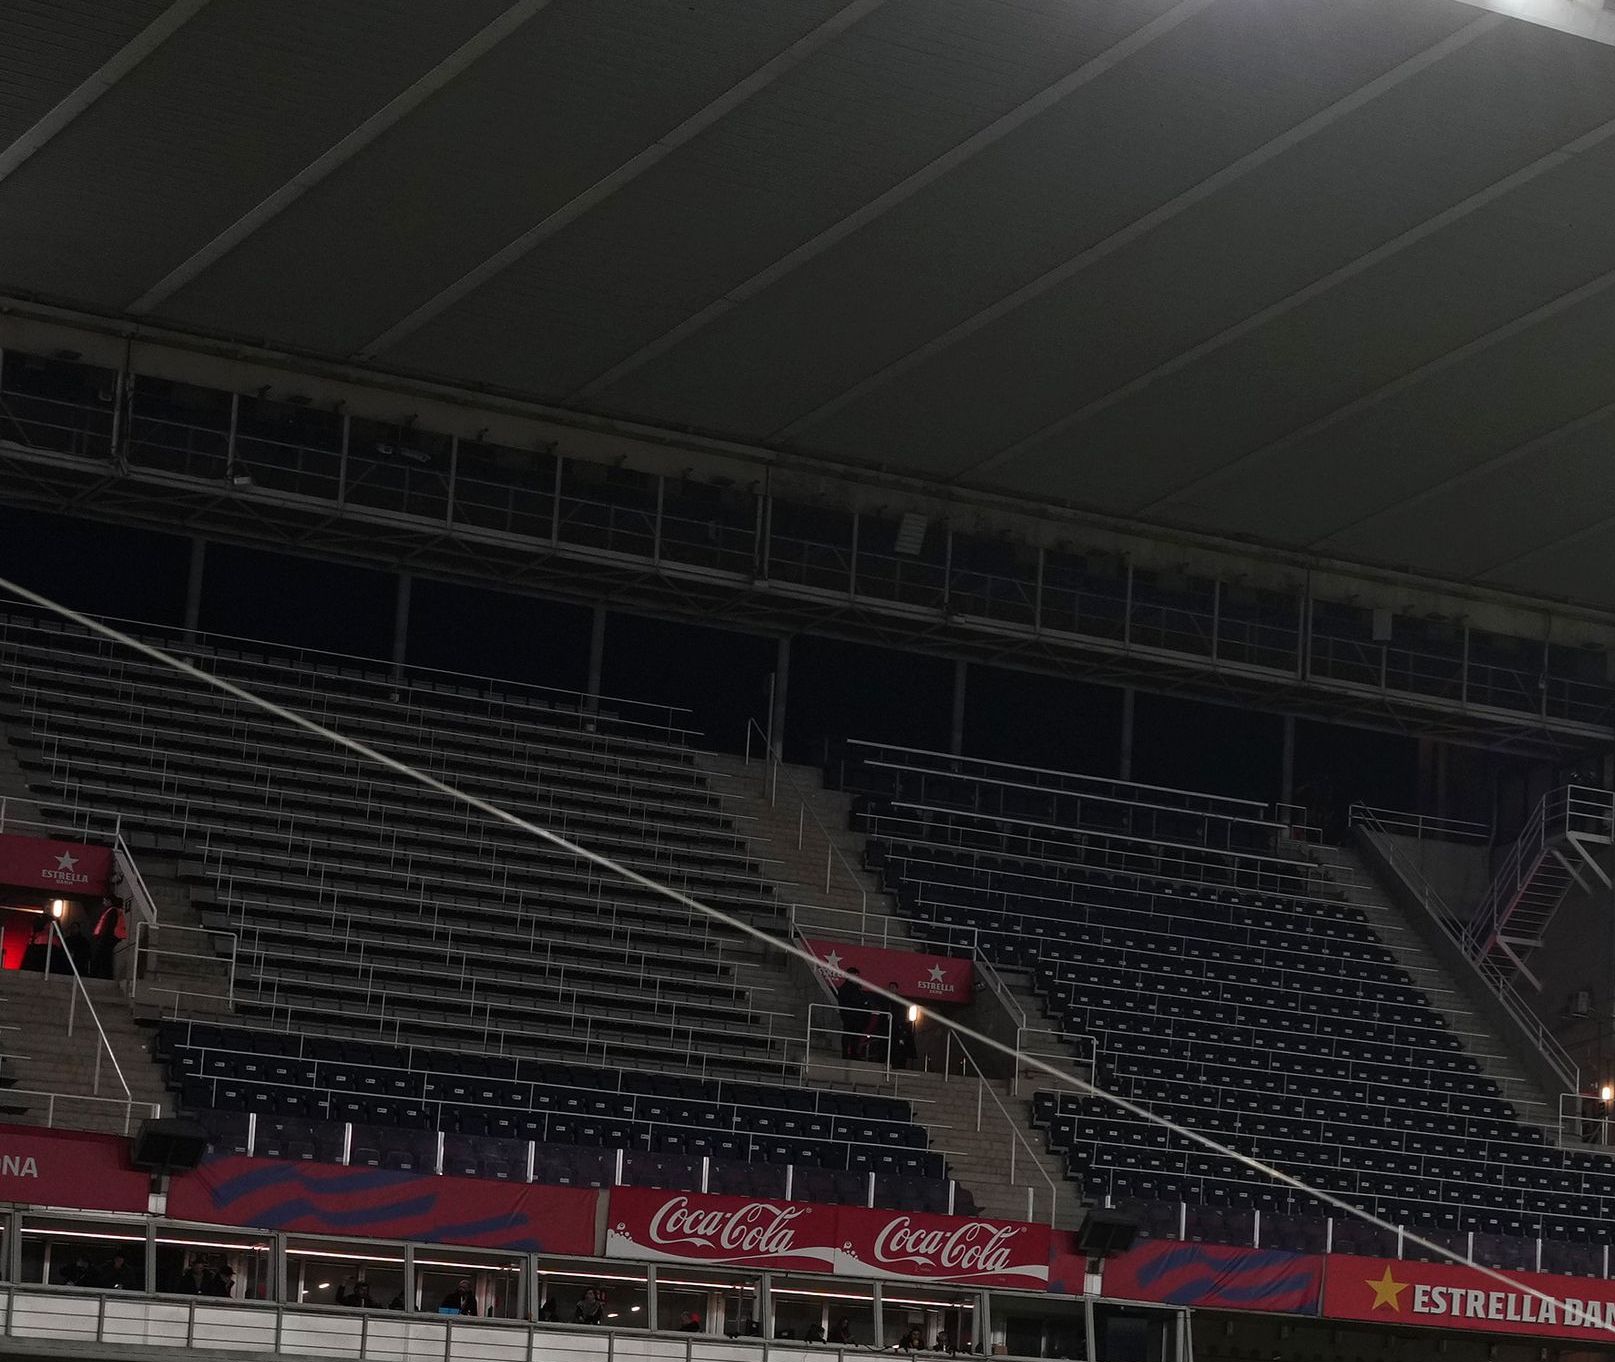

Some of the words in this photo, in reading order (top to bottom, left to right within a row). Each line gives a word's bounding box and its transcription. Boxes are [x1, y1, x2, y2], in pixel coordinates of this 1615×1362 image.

[41, 869, 89, 883] ESTRELLA
[918, 981, 954, 993] ESTRELLA
[0, 1155, 38, 1178] NA
[649, 1196, 805, 1254] Coca-Cola
[874, 1216, 1019, 1271] Coca-Cola
[1413, 1284, 1558, 1325] ESTRELLA
